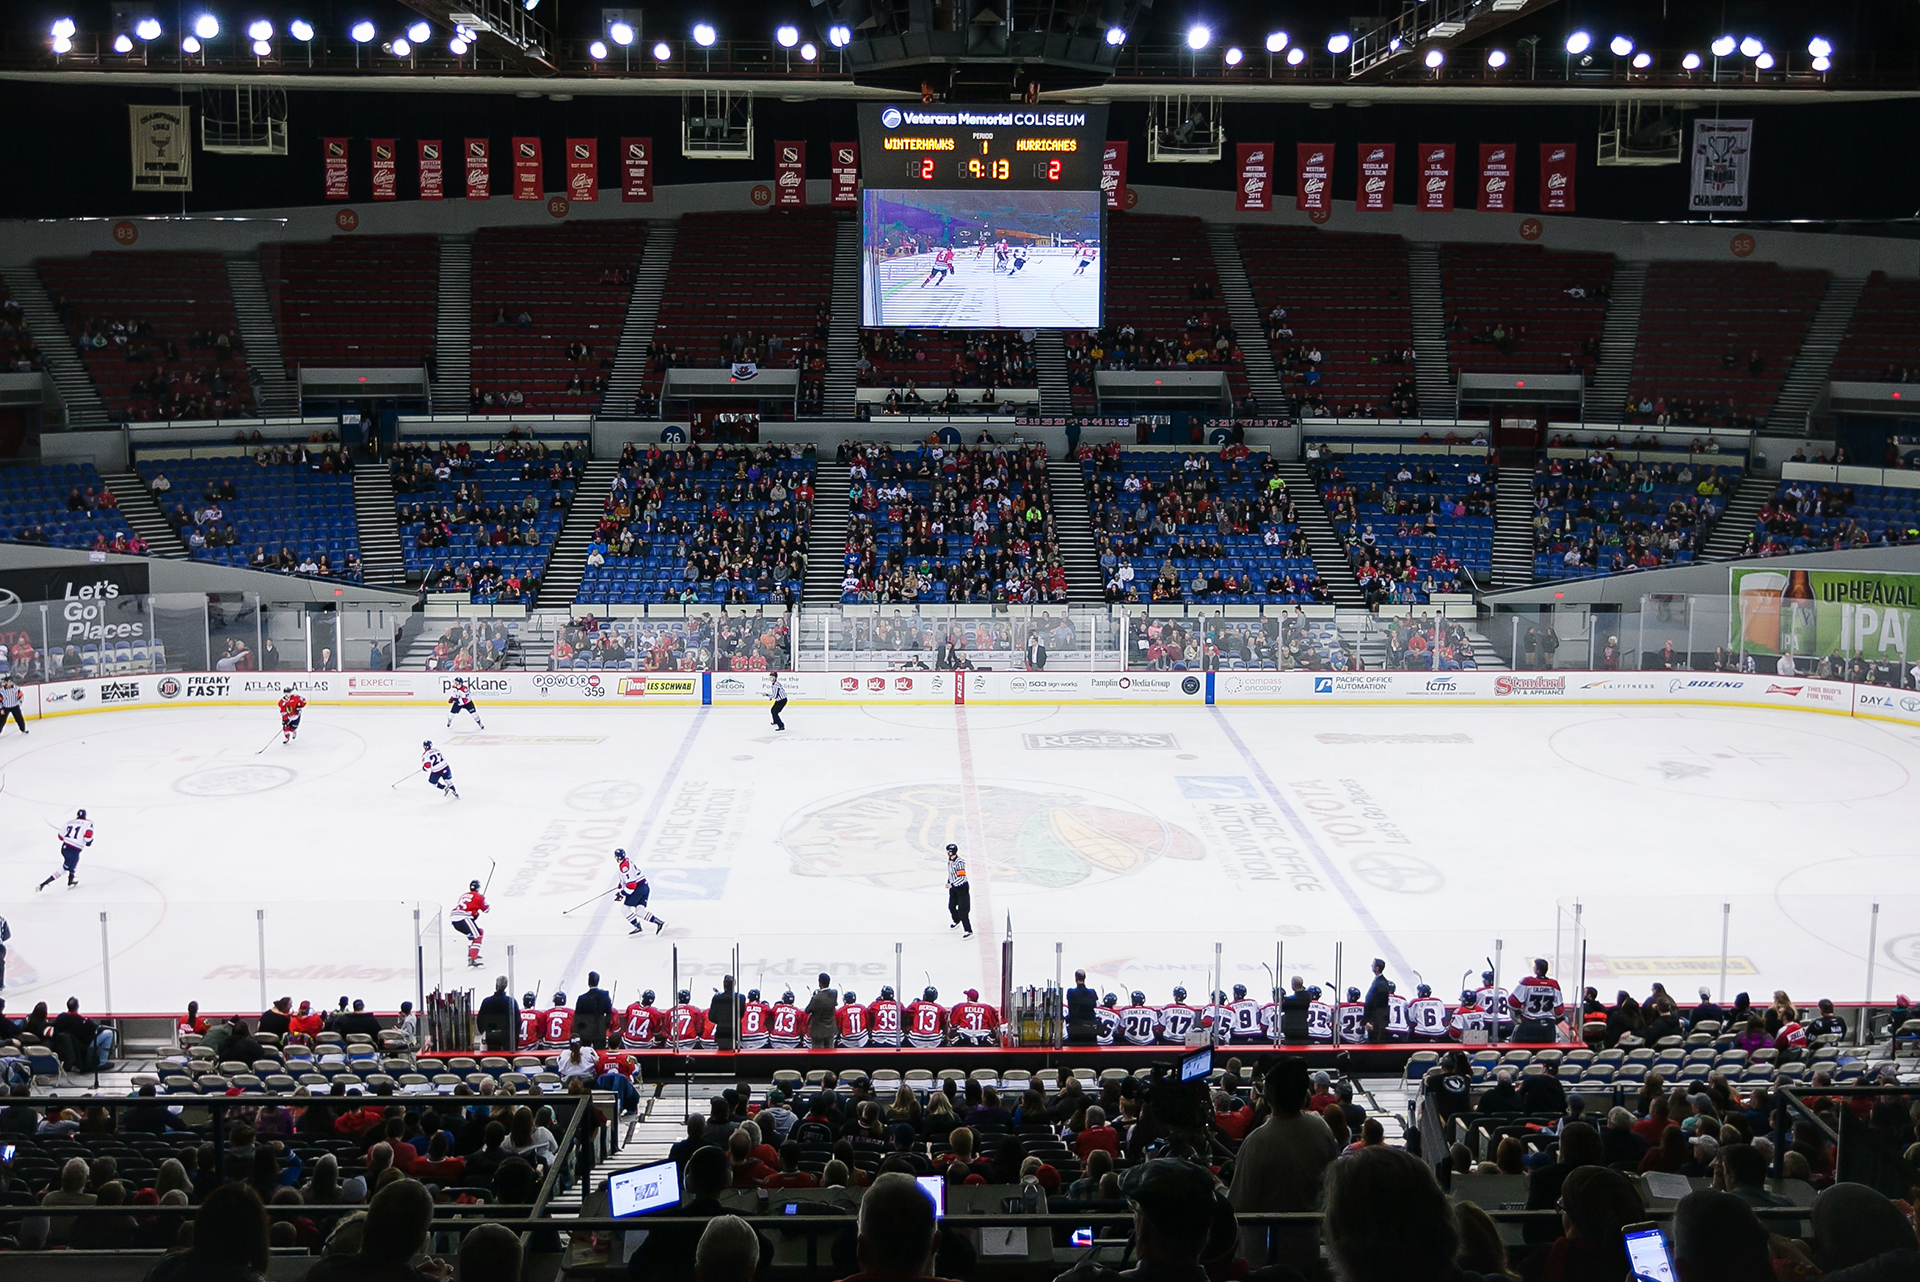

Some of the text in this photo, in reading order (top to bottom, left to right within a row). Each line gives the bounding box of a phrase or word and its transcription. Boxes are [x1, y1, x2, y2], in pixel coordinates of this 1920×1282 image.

[903, 112, 1085, 127] Veterans Memorial COLISEUM
[884, 138, 955, 152] WINTERHAWKS
[1016, 139, 1077, 152] HURRICANES
[921, 159, 934, 180] 2
[968, 159, 1009, 181] 9:13
[1048, 159, 1061, 181] 2
[754, 191, 768, 201] 86
[1693, 195, 1743, 206] CHAMPIONS
[551, 203, 566, 212] 85
[339, 215, 355, 225] 84
[117, 228, 134, 239] 83
[1522, 225, 1538, 236] 54
[1734, 240, 1750, 251] 55
[666, 432, 681, 443] 26
[1217, 434, 1226, 446] 2
[65, 580, 119, 601] Let's
[1823, 580, 1917, 607] UPHEAVAL
[64, 602, 98, 621] Go
[66, 621, 143, 642] Places
[1841, 604, 1905, 653] IPA
[1781, 633, 1800, 652] IPA
[101, 682, 139, 693] BASE
[188, 676, 231, 685] FREAKY
[244, 682, 282, 692] ATLAS
[291, 682, 329, 692] ATLAS
[360, 679, 394, 687] EXPECT
[536, 677, 586, 687] POWER
[647, 683, 659, 691] LES
[660, 682, 692, 691] SCHWAB
[1048, 682, 1060, 691] sign
[1061, 681, 1078, 690] works
[1091, 678, 1170, 688] Pamplin Media Group
[1245, 678, 1282, 686] compass
[1245, 685, 1282, 693] oncology
[1425, 680, 1457, 691] tcms
[1494, 676, 1565, 696] Standard
[1687, 681, 1744, 689] BOEING
[101, 690, 140, 701] CAMP
[187, 686, 230, 697] FAST!
[1860, 695, 1884, 705] DAY
[1035, 733, 1168, 748] RESER'S
[1287, 779, 1376, 848] TOYOTA
[1338, 778, 1412, 845] Let's Go Places
[647, 781, 709, 863] PACIFIC OFFICE
[685, 788, 737, 862] AUTOMATION
[64, 826, 82, 840] 21
[1206, 803, 1281, 881] AUTOMATION
[1240, 802, 1326, 892] PACIFIC OFFICE
[503, 818, 578, 898] Let's Go Places
[537, 815, 629, 898] TOYOTA
[679, 958, 888, 977] parklane
[1611, 960, 1746, 971] LES SCHWAB
[1485, 996, 1508, 1014] 28
[747, 1012, 760, 1032] 8
[774, 1012, 796, 1033] 43
[849, 1013, 861, 1033] 11
[877, 1010, 897, 1030] 39
[918, 1010, 937, 1031] 13
[965, 1013, 983, 1031] 31
[1127, 1016, 1151, 1036] 20
[1170, 1015, 1192, 1034] 17
[1239, 1009, 1252, 1029] 9
[1307, 1010, 1328, 1028] 25
[1424, 1008, 1436, 1027] 6
[551, 1017, 563, 1038] 6
[627, 1016, 650, 1038] 44
